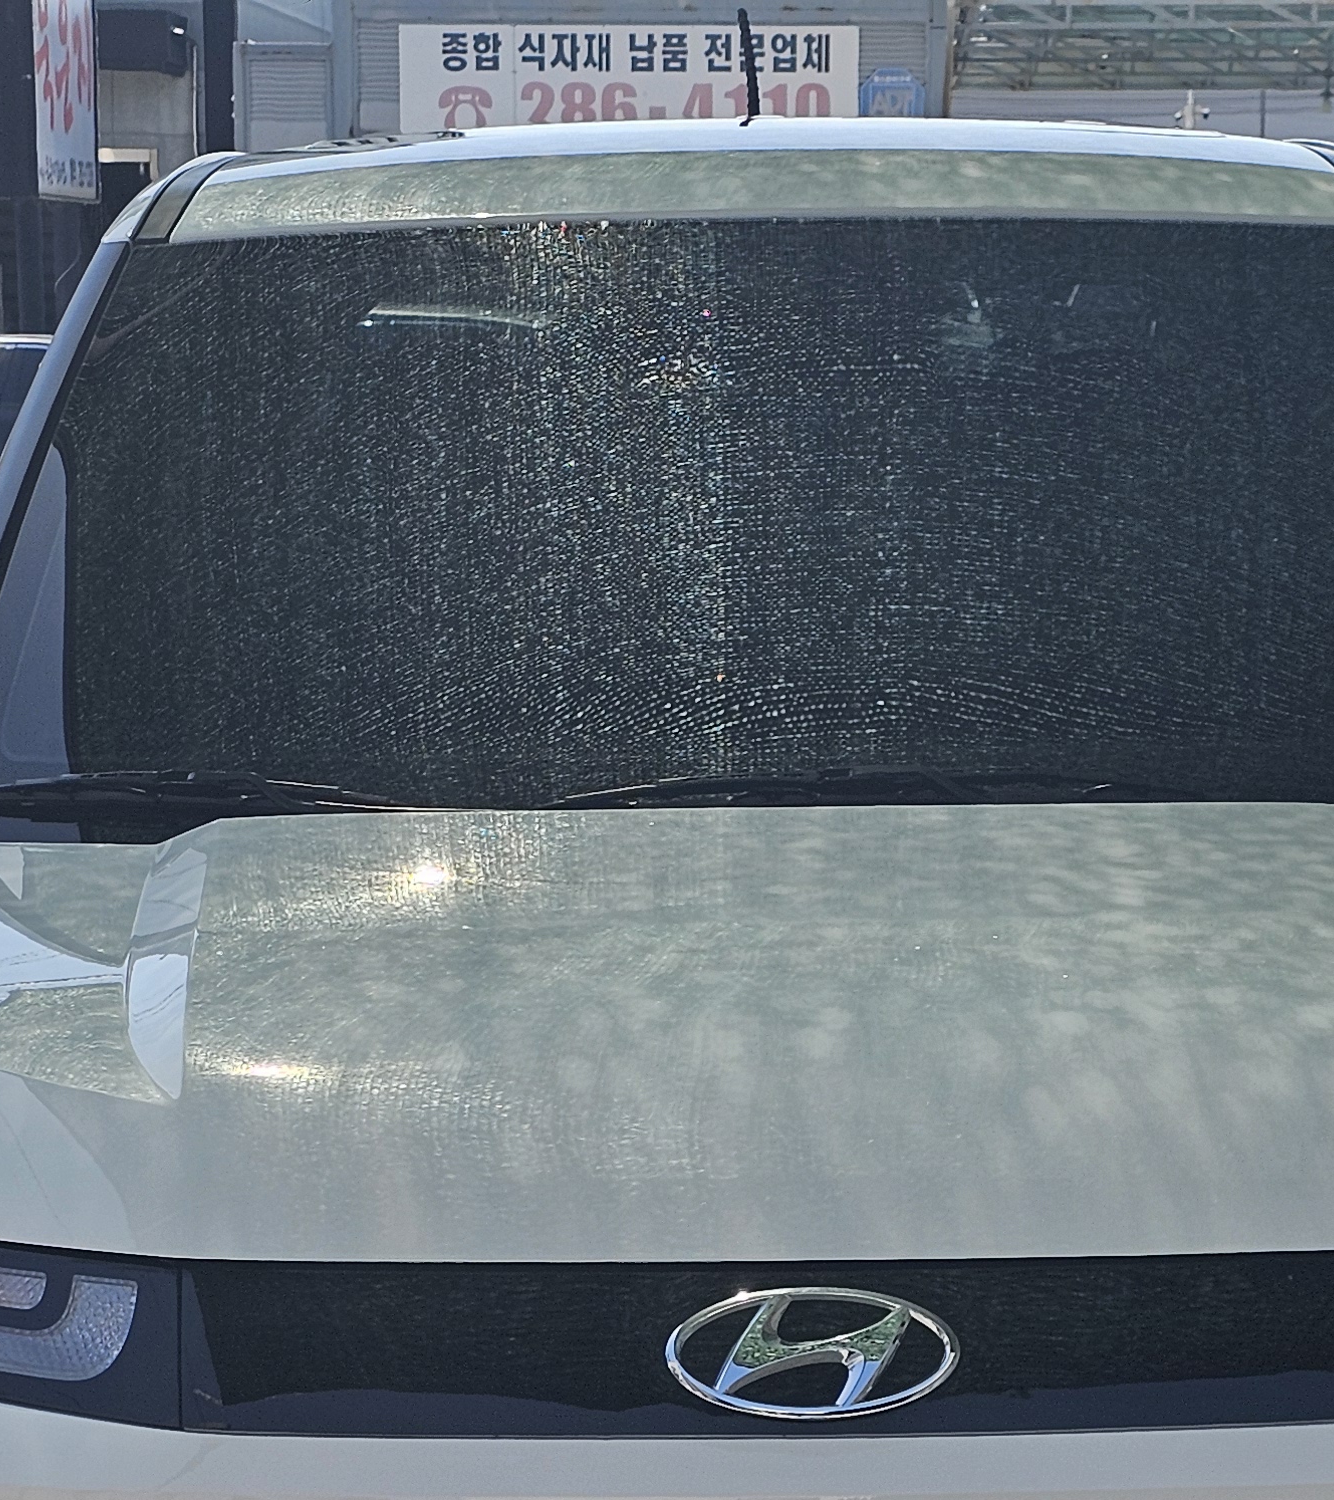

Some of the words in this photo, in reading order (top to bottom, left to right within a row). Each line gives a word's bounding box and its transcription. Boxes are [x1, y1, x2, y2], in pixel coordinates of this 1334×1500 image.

[442, 31, 502, 72] 종합
[518, 32, 611, 72] 식자재
[629, 32, 688, 73] 납품
